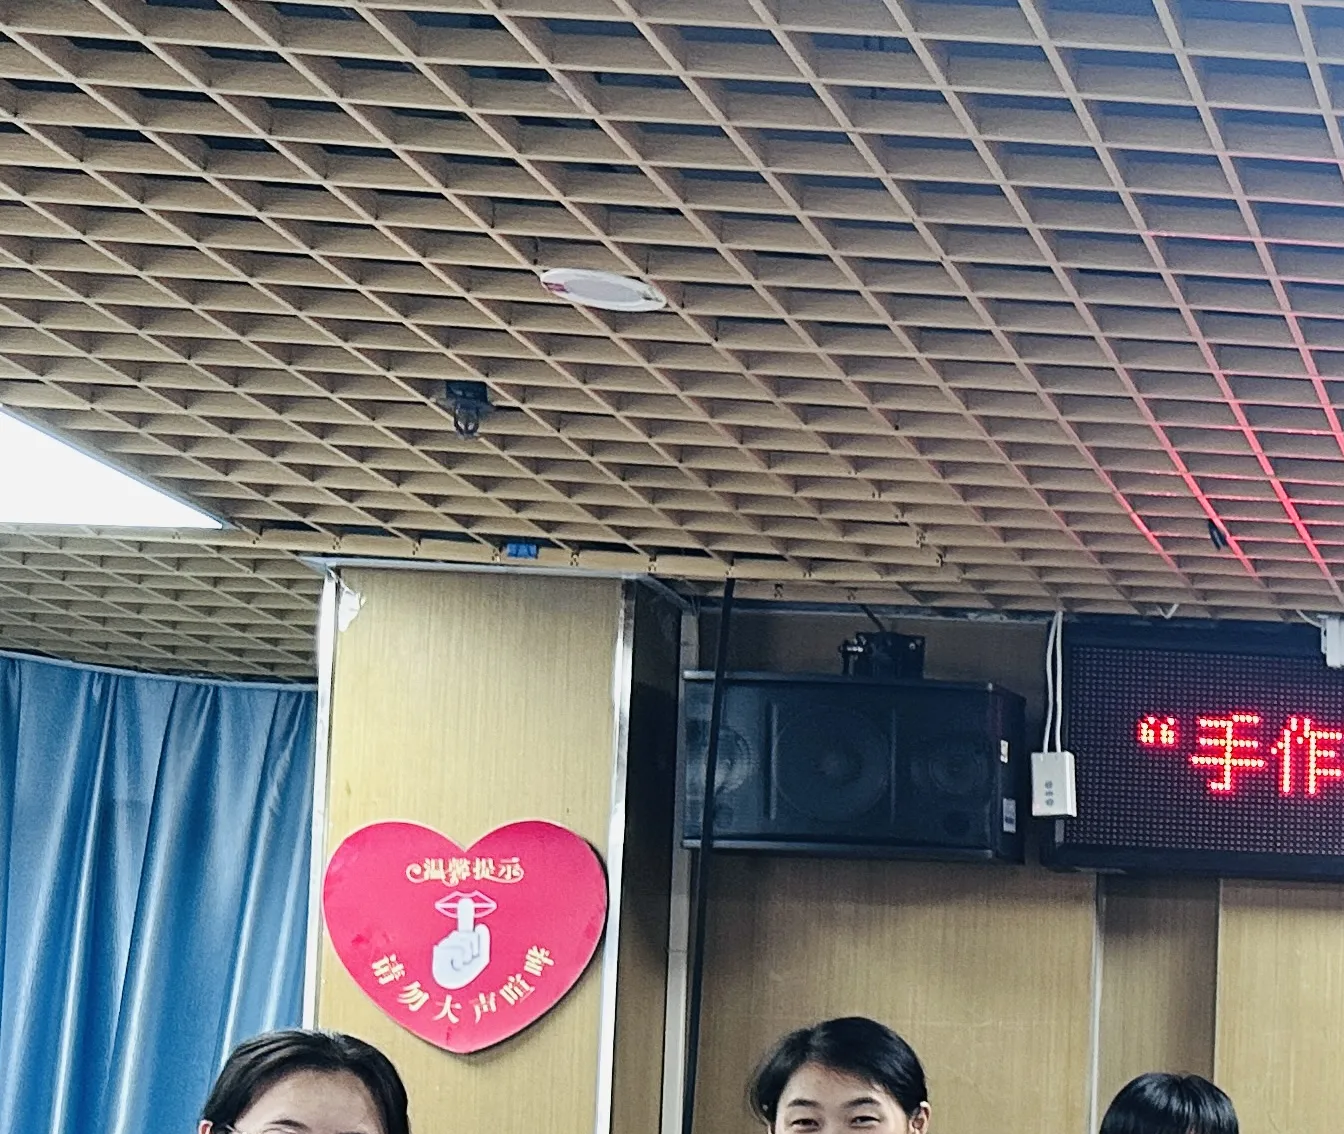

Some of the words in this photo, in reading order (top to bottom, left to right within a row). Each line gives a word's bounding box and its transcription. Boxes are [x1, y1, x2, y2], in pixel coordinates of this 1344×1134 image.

[371, 945, 556, 1024] 请勿大声喧哗
